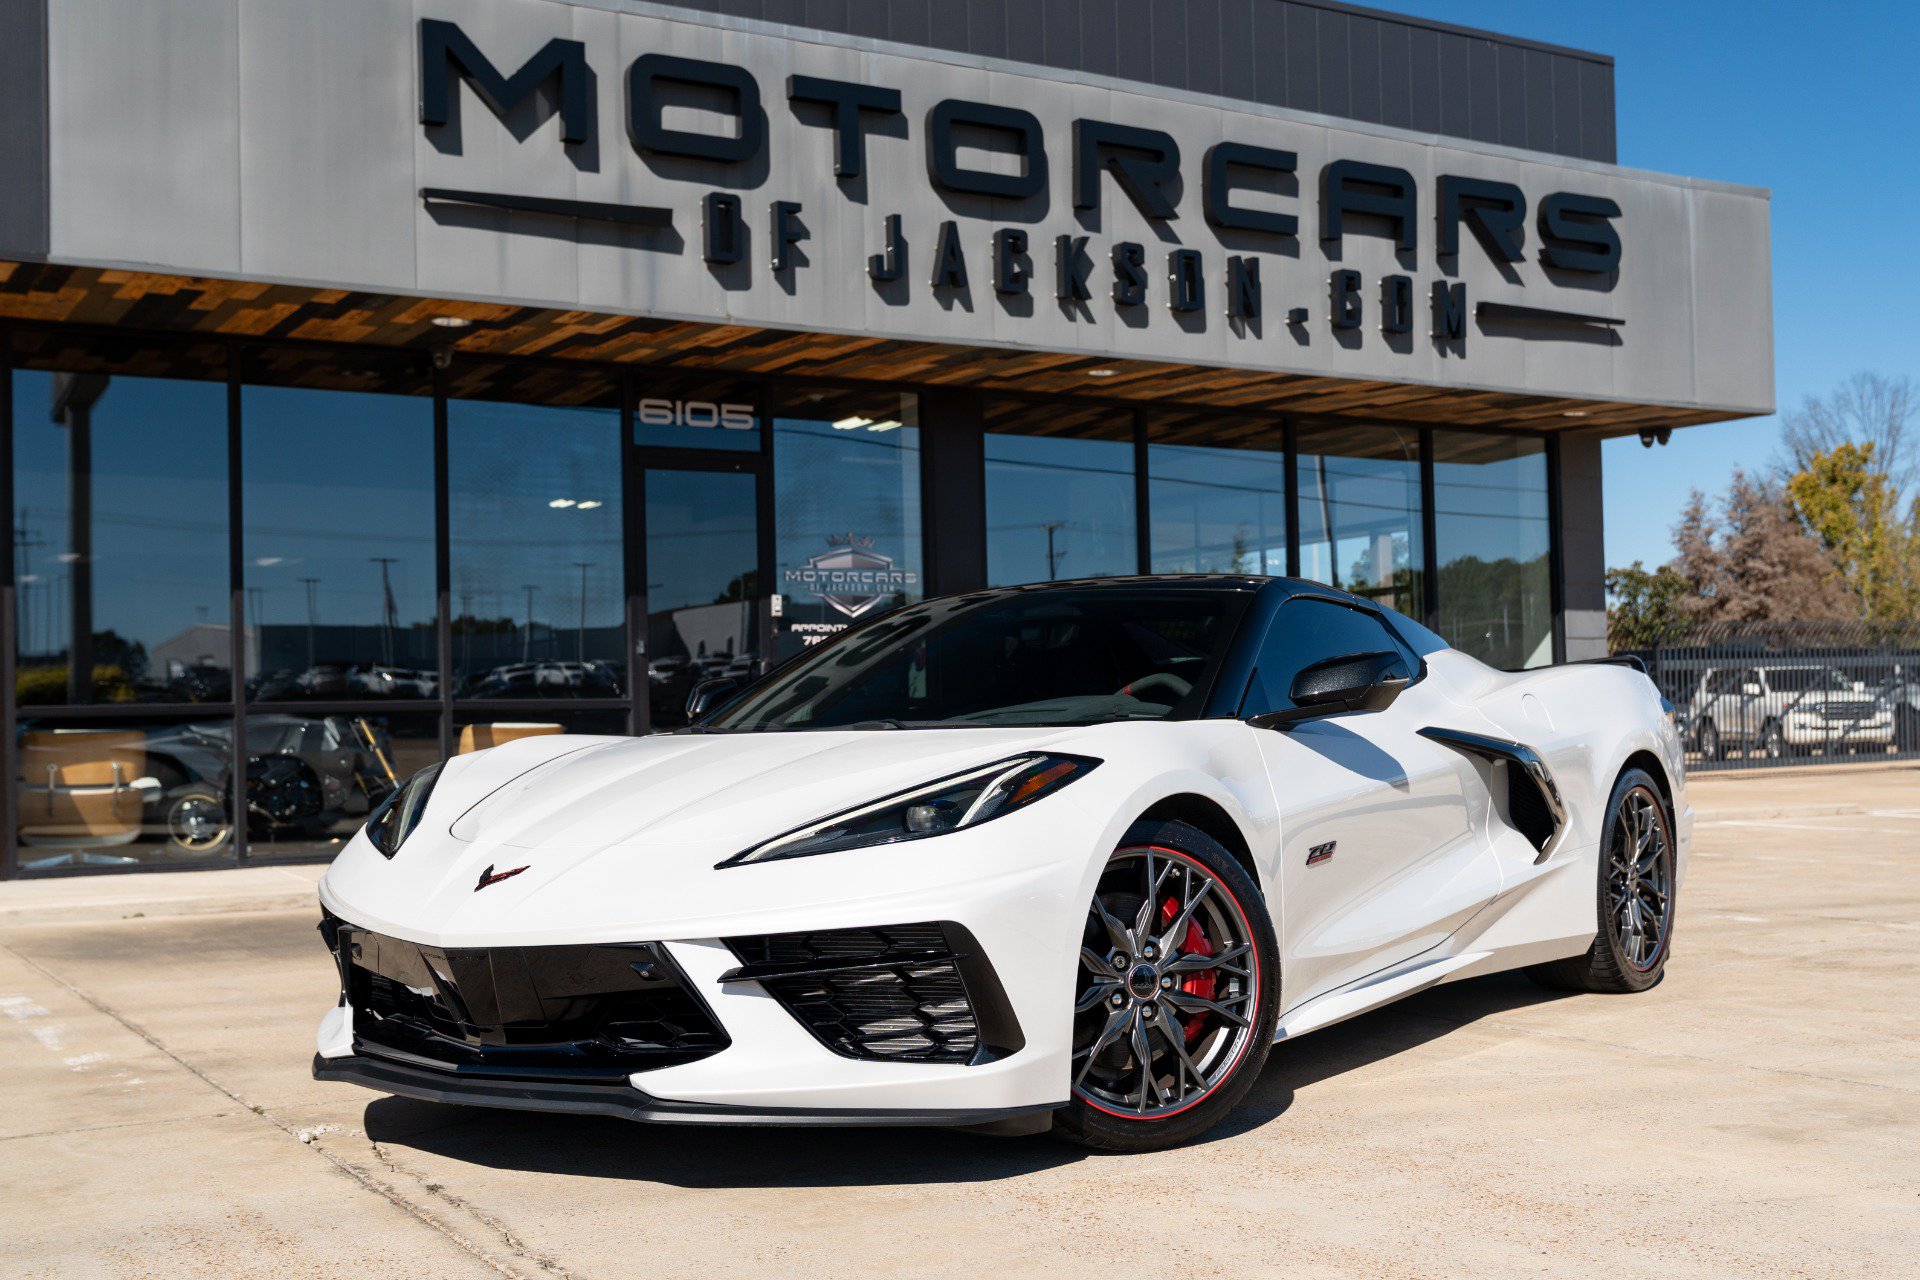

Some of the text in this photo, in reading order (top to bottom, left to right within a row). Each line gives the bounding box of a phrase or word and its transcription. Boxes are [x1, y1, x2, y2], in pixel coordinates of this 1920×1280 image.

[419, 18, 1622, 274] MOTORCARS
[702, 192, 1466, 340] OF JACKSON.COM
[639, 398, 754, 430] 6105
[785, 570, 917, 583] MOTORCARS
